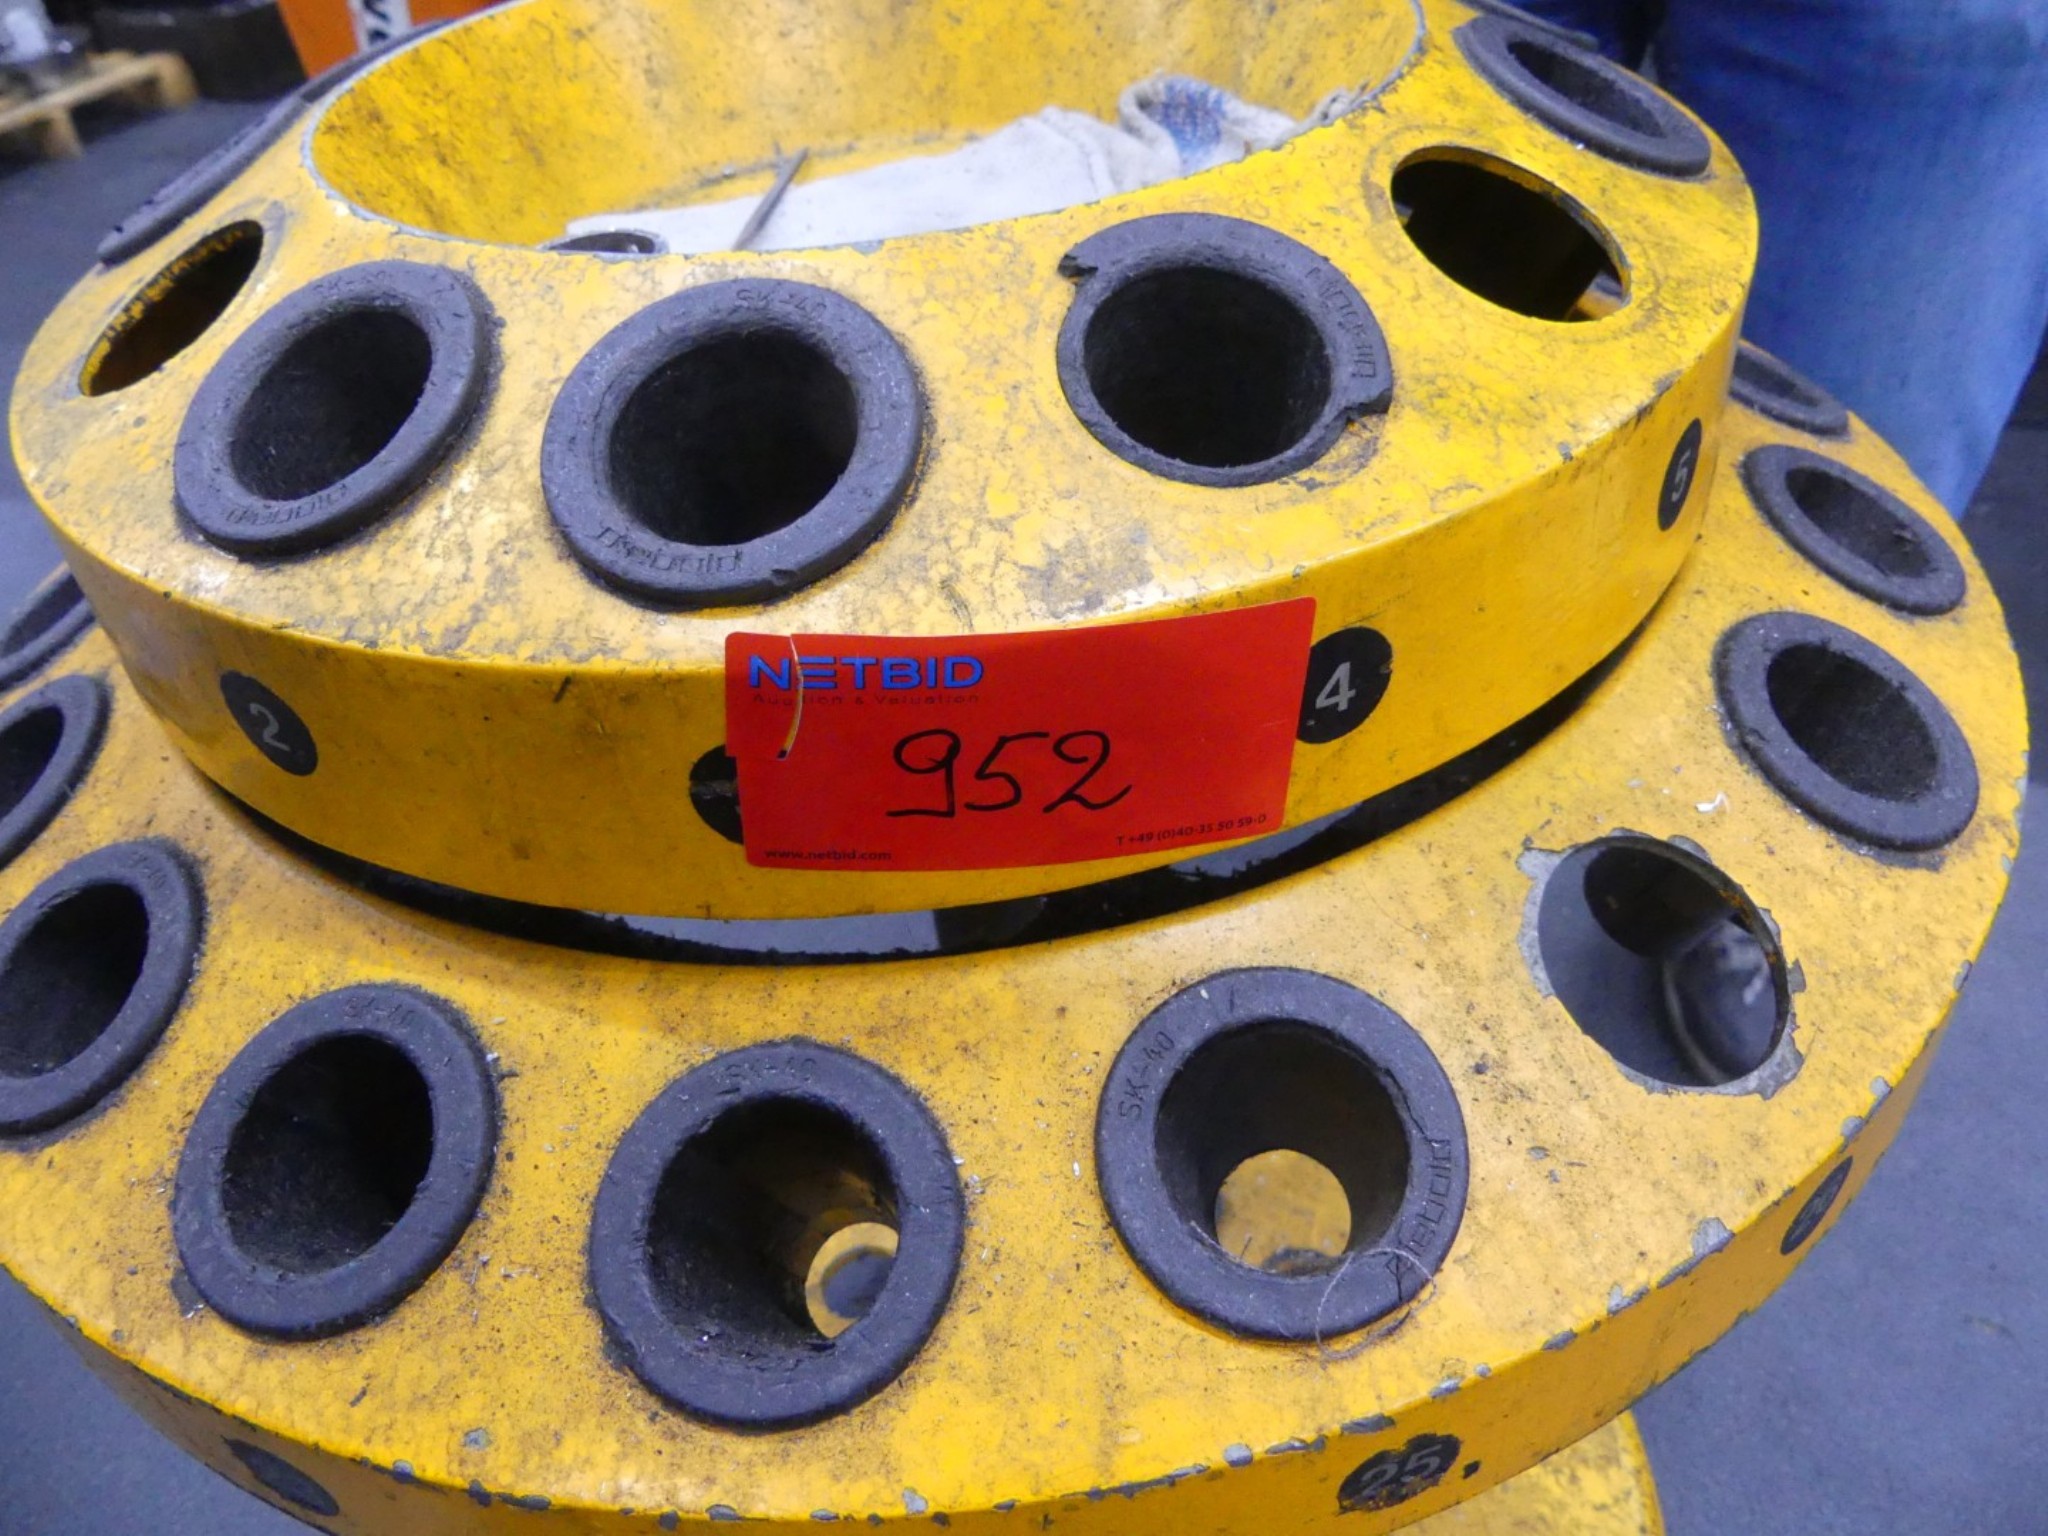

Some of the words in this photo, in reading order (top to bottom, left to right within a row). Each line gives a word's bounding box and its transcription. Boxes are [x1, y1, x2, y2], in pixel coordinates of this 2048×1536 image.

[1670, 447, 1693, 503] 5
[749, 655, 985, 691] NETBID
[1315, 661, 1357, 713] 4
[854, 694, 865, 706] &
[876, 693, 980, 706] Valuation
[249, 702, 292, 753] 2
[884, 727, 1133, 819] 952
[764, 849, 893, 861] www.netbid.com
[1116, 835, 1125, 846] T
[1128, 831, 1154, 844] +49
[1157, 822, 1213, 841] (0)40-35
[1217, 819, 1234, 832] 50
[1237, 813, 1267, 829] 59-0
[1117, 1030, 1176, 1121] SK-40
[1358, 1443, 1443, 1501] 25
